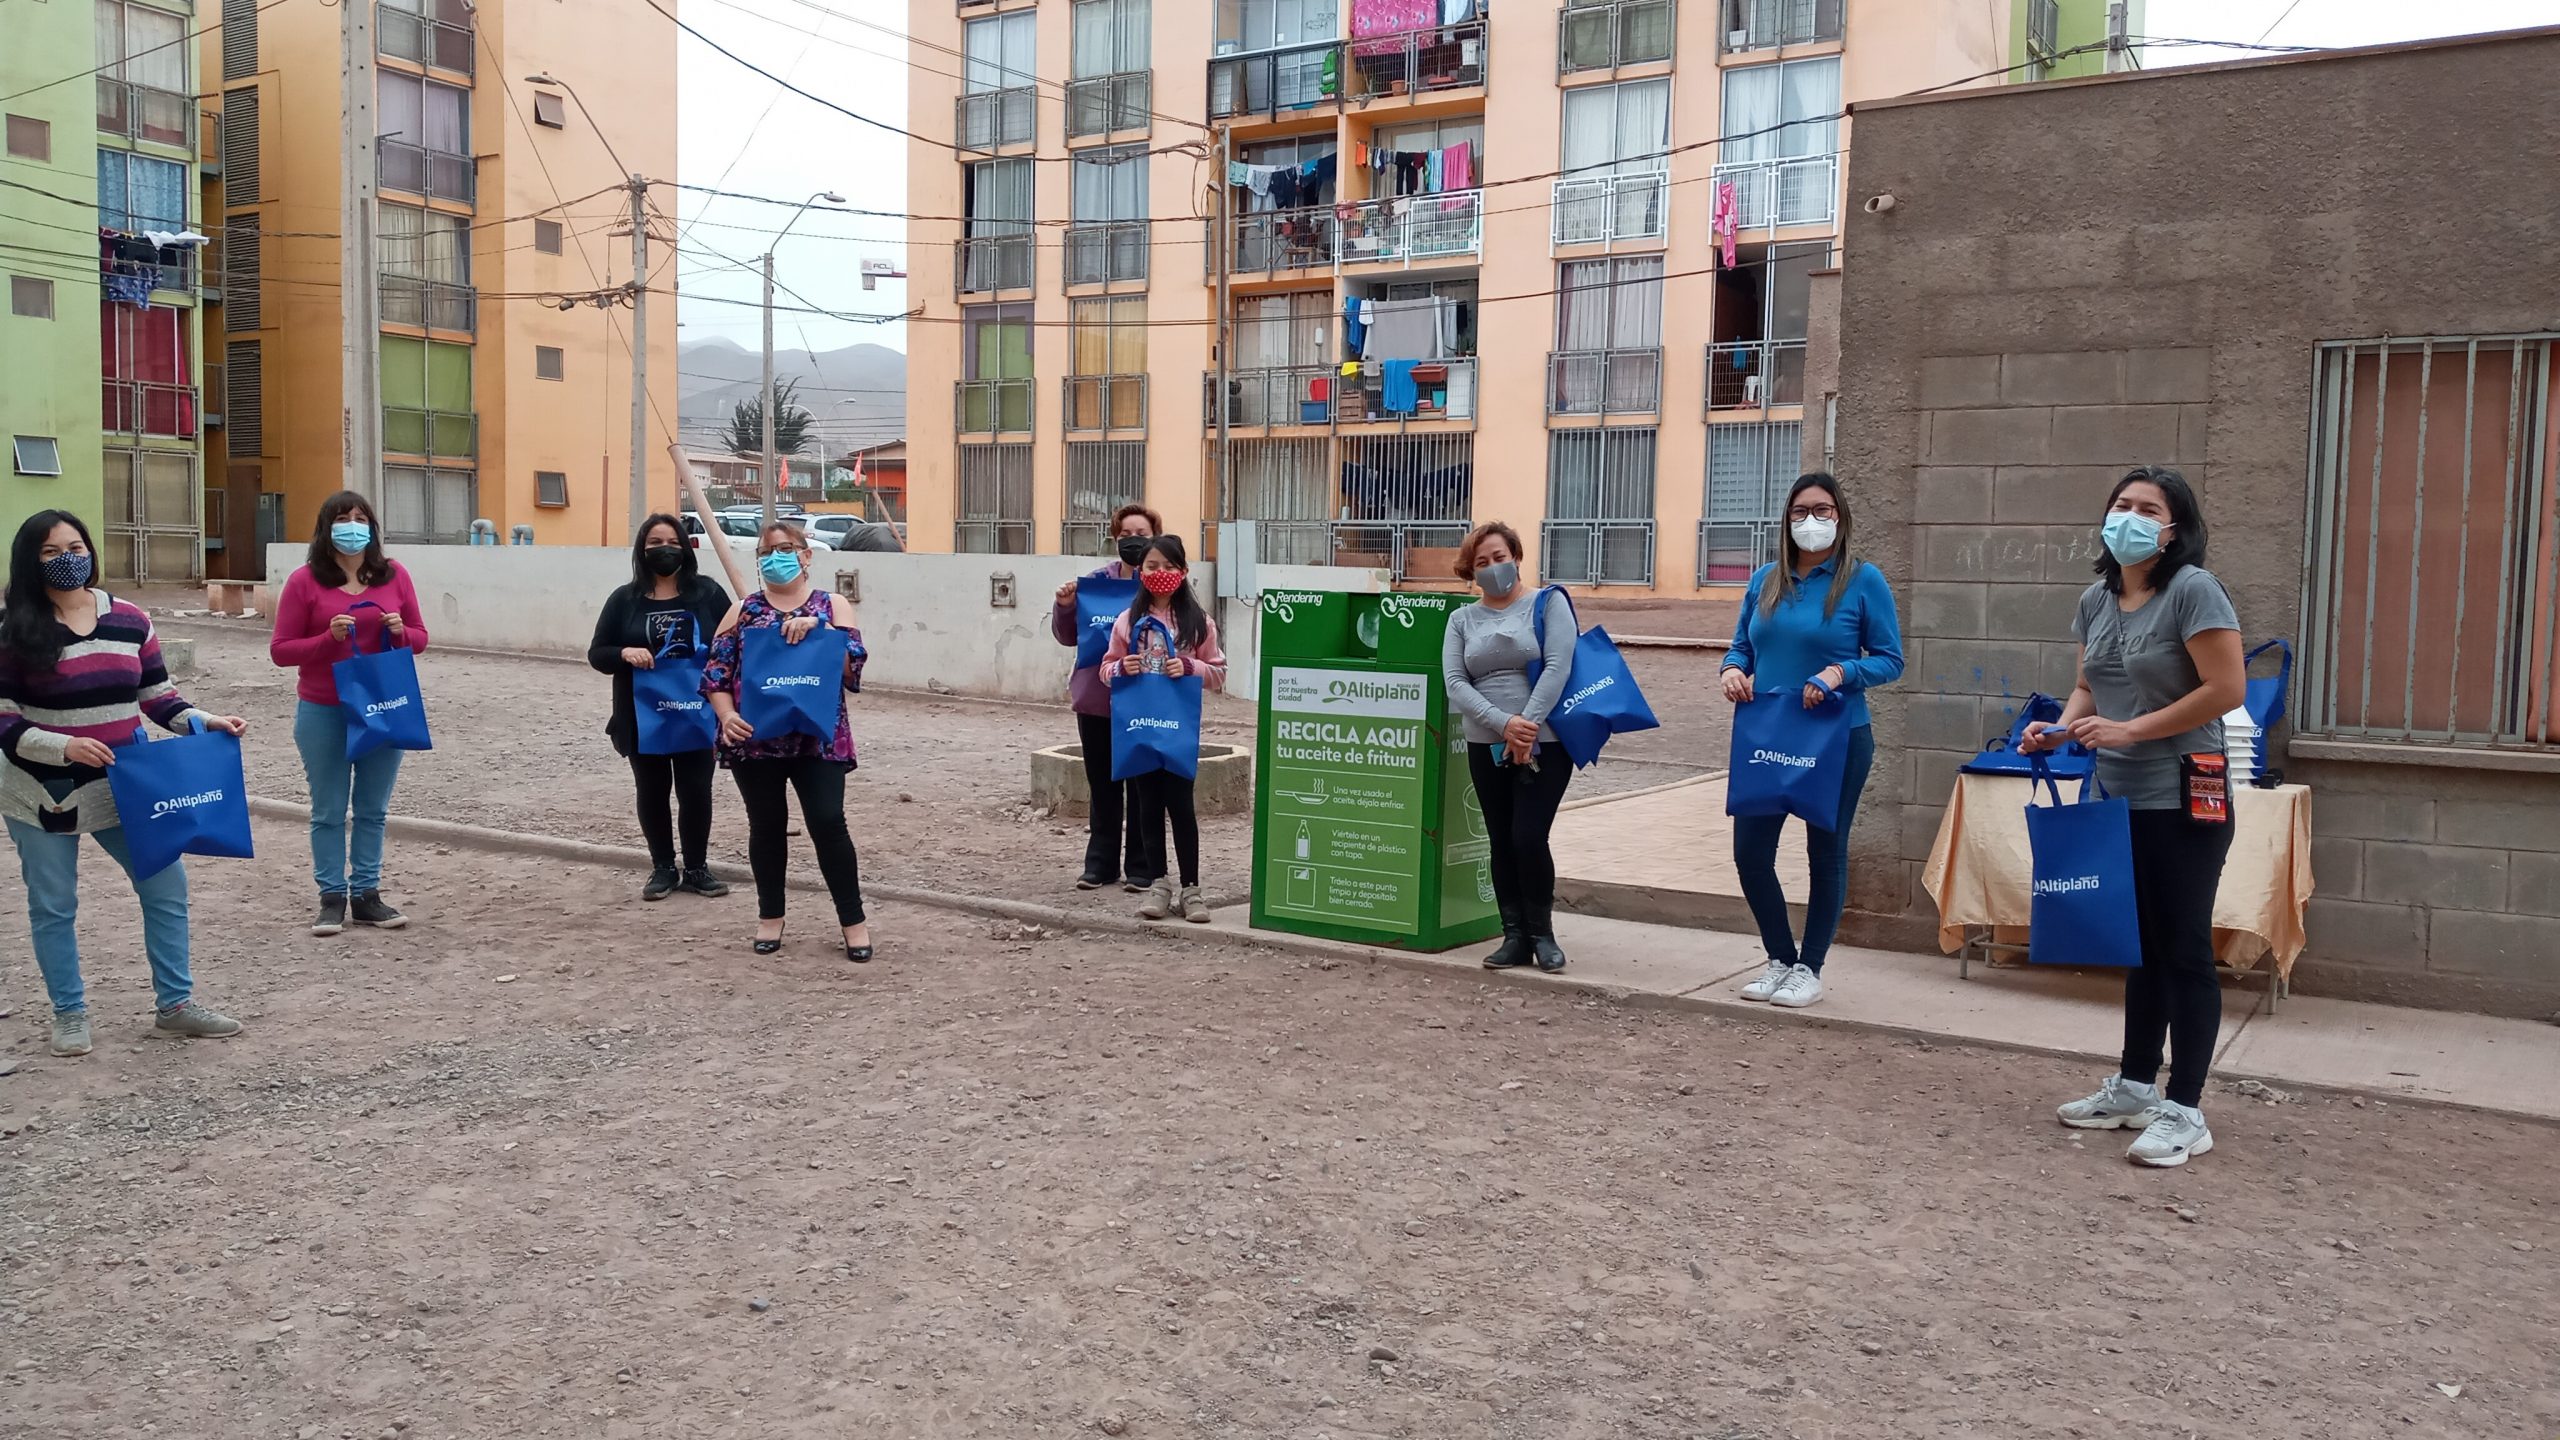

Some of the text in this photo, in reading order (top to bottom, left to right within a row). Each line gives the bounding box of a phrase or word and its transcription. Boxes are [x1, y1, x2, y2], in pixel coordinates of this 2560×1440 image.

[1276, 591, 1323, 607] Rendering
[1395, 595, 1446, 611] Rendering
[777, 675, 820, 686] Altiplano
[1277, 693, 1302, 702] ciudad
[1291, 686, 1318, 695] nuestra
[1346, 681, 1420, 702] Altiplano
[1573, 678, 1614, 702] Altiplano
[666, 701, 703, 711] Altiplano
[1139, 718, 1179, 729] Altiplano
[1277, 720, 1419, 748] RECICLA AQUÍ
[1276, 743, 1416, 768] tu aceite de fritura
[1765, 751, 1816, 768] Altiplano
[1333, 786, 1348, 794] Una
[1363, 789, 1384, 798] usado
[1386, 790, 1393, 799] el
[169, 791, 223, 810] Altiplano
[1331, 829, 1359, 840] Viértelo
[1331, 840, 1407, 854] recipiente de plástico
[1330, 876, 1351, 887] Tráelo
[1359, 881, 1374, 890] este
[1375, 883, 1398, 893] punto
[2040, 878, 2099, 894] Altiplano
[1328, 896, 1344, 904] bien
[1329, 886, 1351, 897] limpio
[1353, 890, 1358, 899] y
